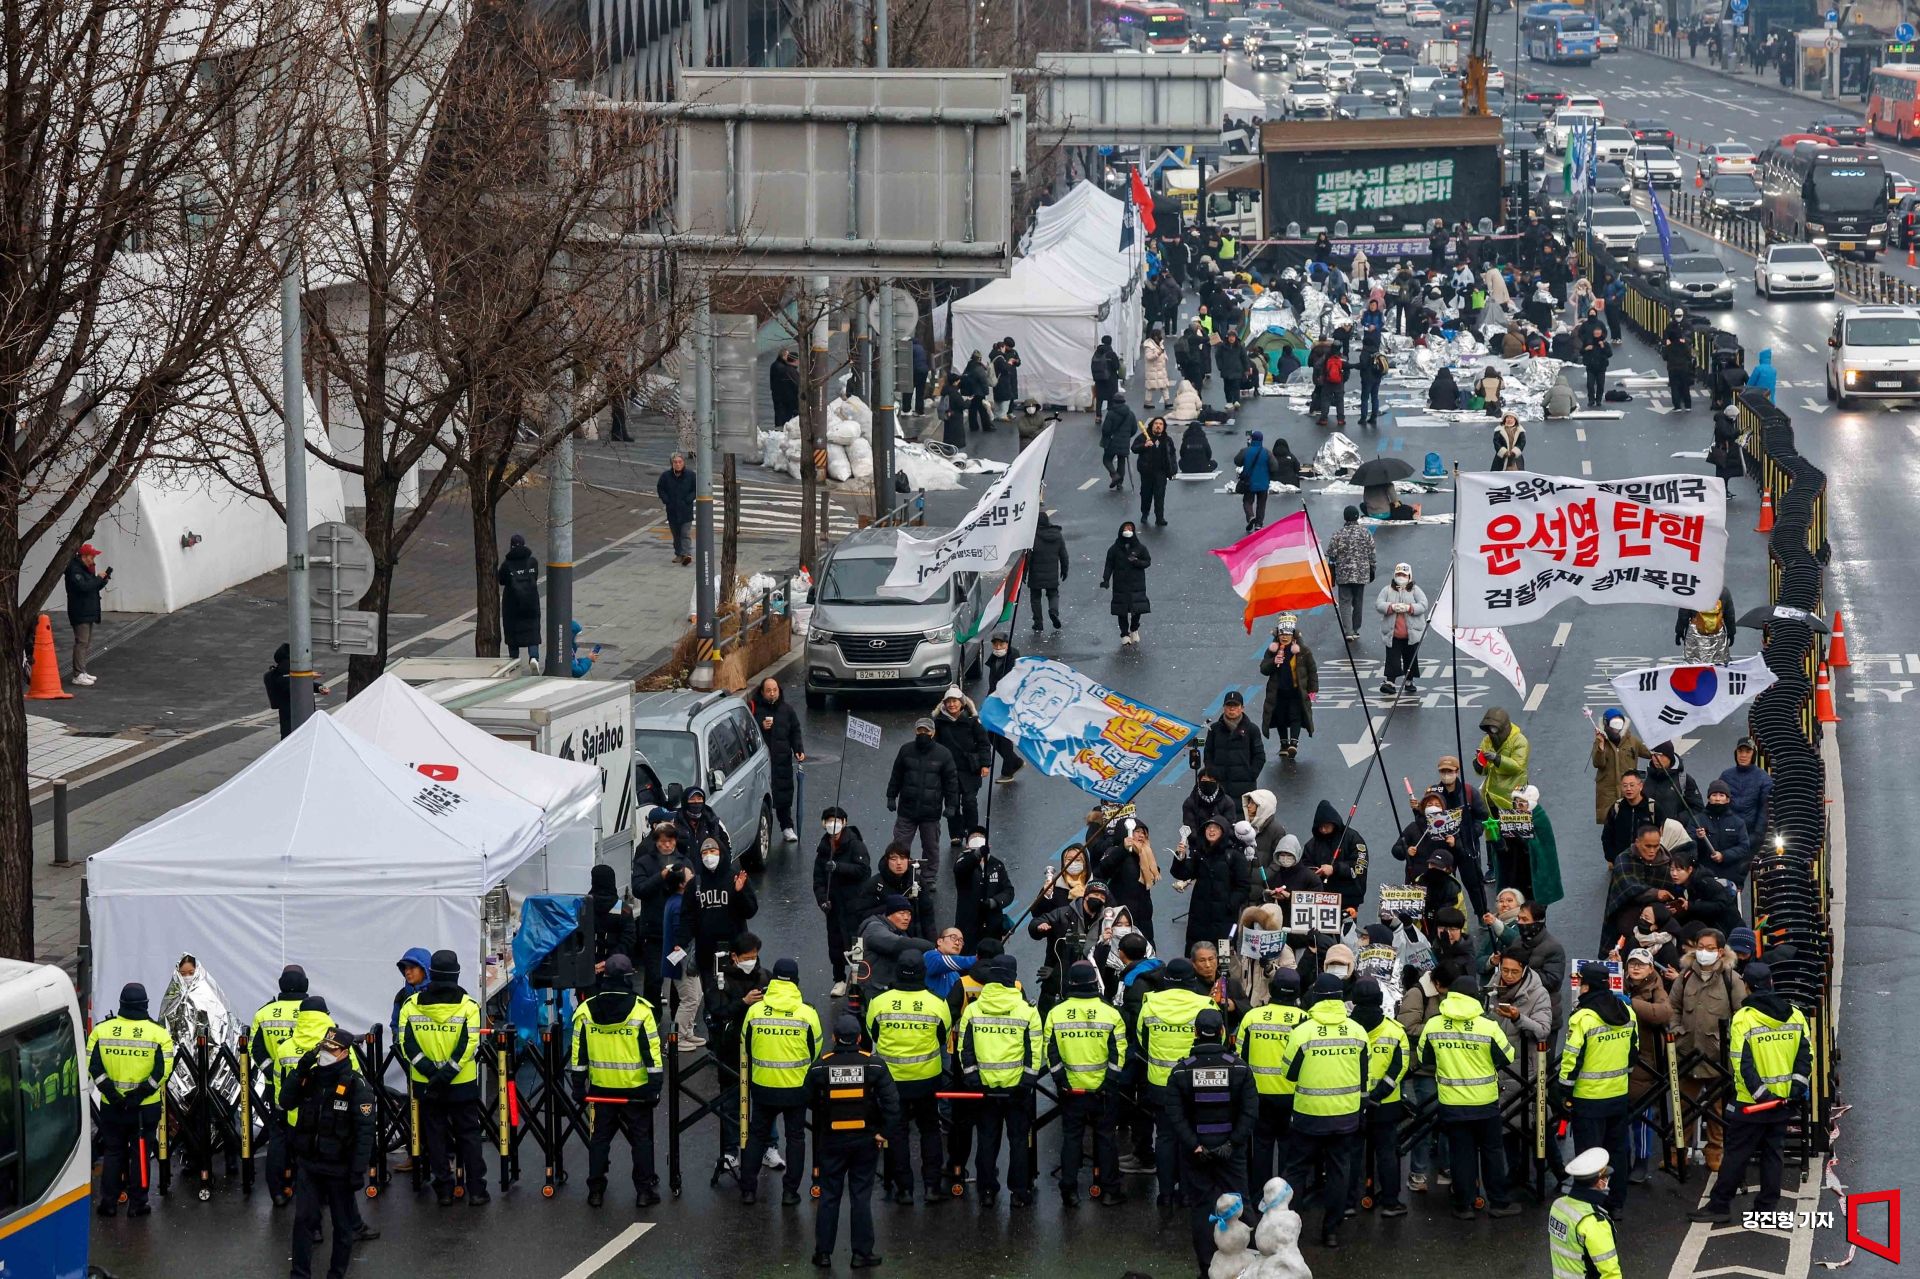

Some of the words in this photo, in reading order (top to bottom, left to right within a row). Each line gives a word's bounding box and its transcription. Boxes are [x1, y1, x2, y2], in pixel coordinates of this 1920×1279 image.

[1317, 167, 1385, 190] 내란수괴
[1388, 159, 1454, 184] 윤석열을
[1317, 189, 1358, 214] 즉각
[1362, 178, 1453, 208] 체포하라!
[1480, 498, 1599, 575] 윤석열
[1613, 501, 1704, 562] 탄핵
[1484, 568, 1584, 609] 검찰독재
[1591, 566, 1701, 596] 경제폭망
[582, 722, 623, 765] Sajahoo
[700, 889, 728, 908] POLO
[1315, 893, 1337, 904] 윤석열
[1295, 907, 1337, 929] 파면
[1261, 932, 1284, 945] 체포!
[1260, 942, 1283, 955] 구속!
[415, 1024, 457, 1033] POLICE
[886, 1022, 929, 1030] POLICE
[974, 1026, 1017, 1035] POLICE
[1153, 1025, 1195, 1033] POLICE
[757, 1028, 801, 1036] POLICE
[1255, 1032, 1289, 1041] POLIC
[1598, 1031, 1630, 1042] POLICE
[1757, 1032, 1794, 1043] POLICE
[1312, 1047, 1357, 1057] POLICE
[1438, 1042, 1479, 1051] POLICE
[105, 1048, 149, 1057] POLICE
[1671, 1062, 1679, 1102] POLICE
